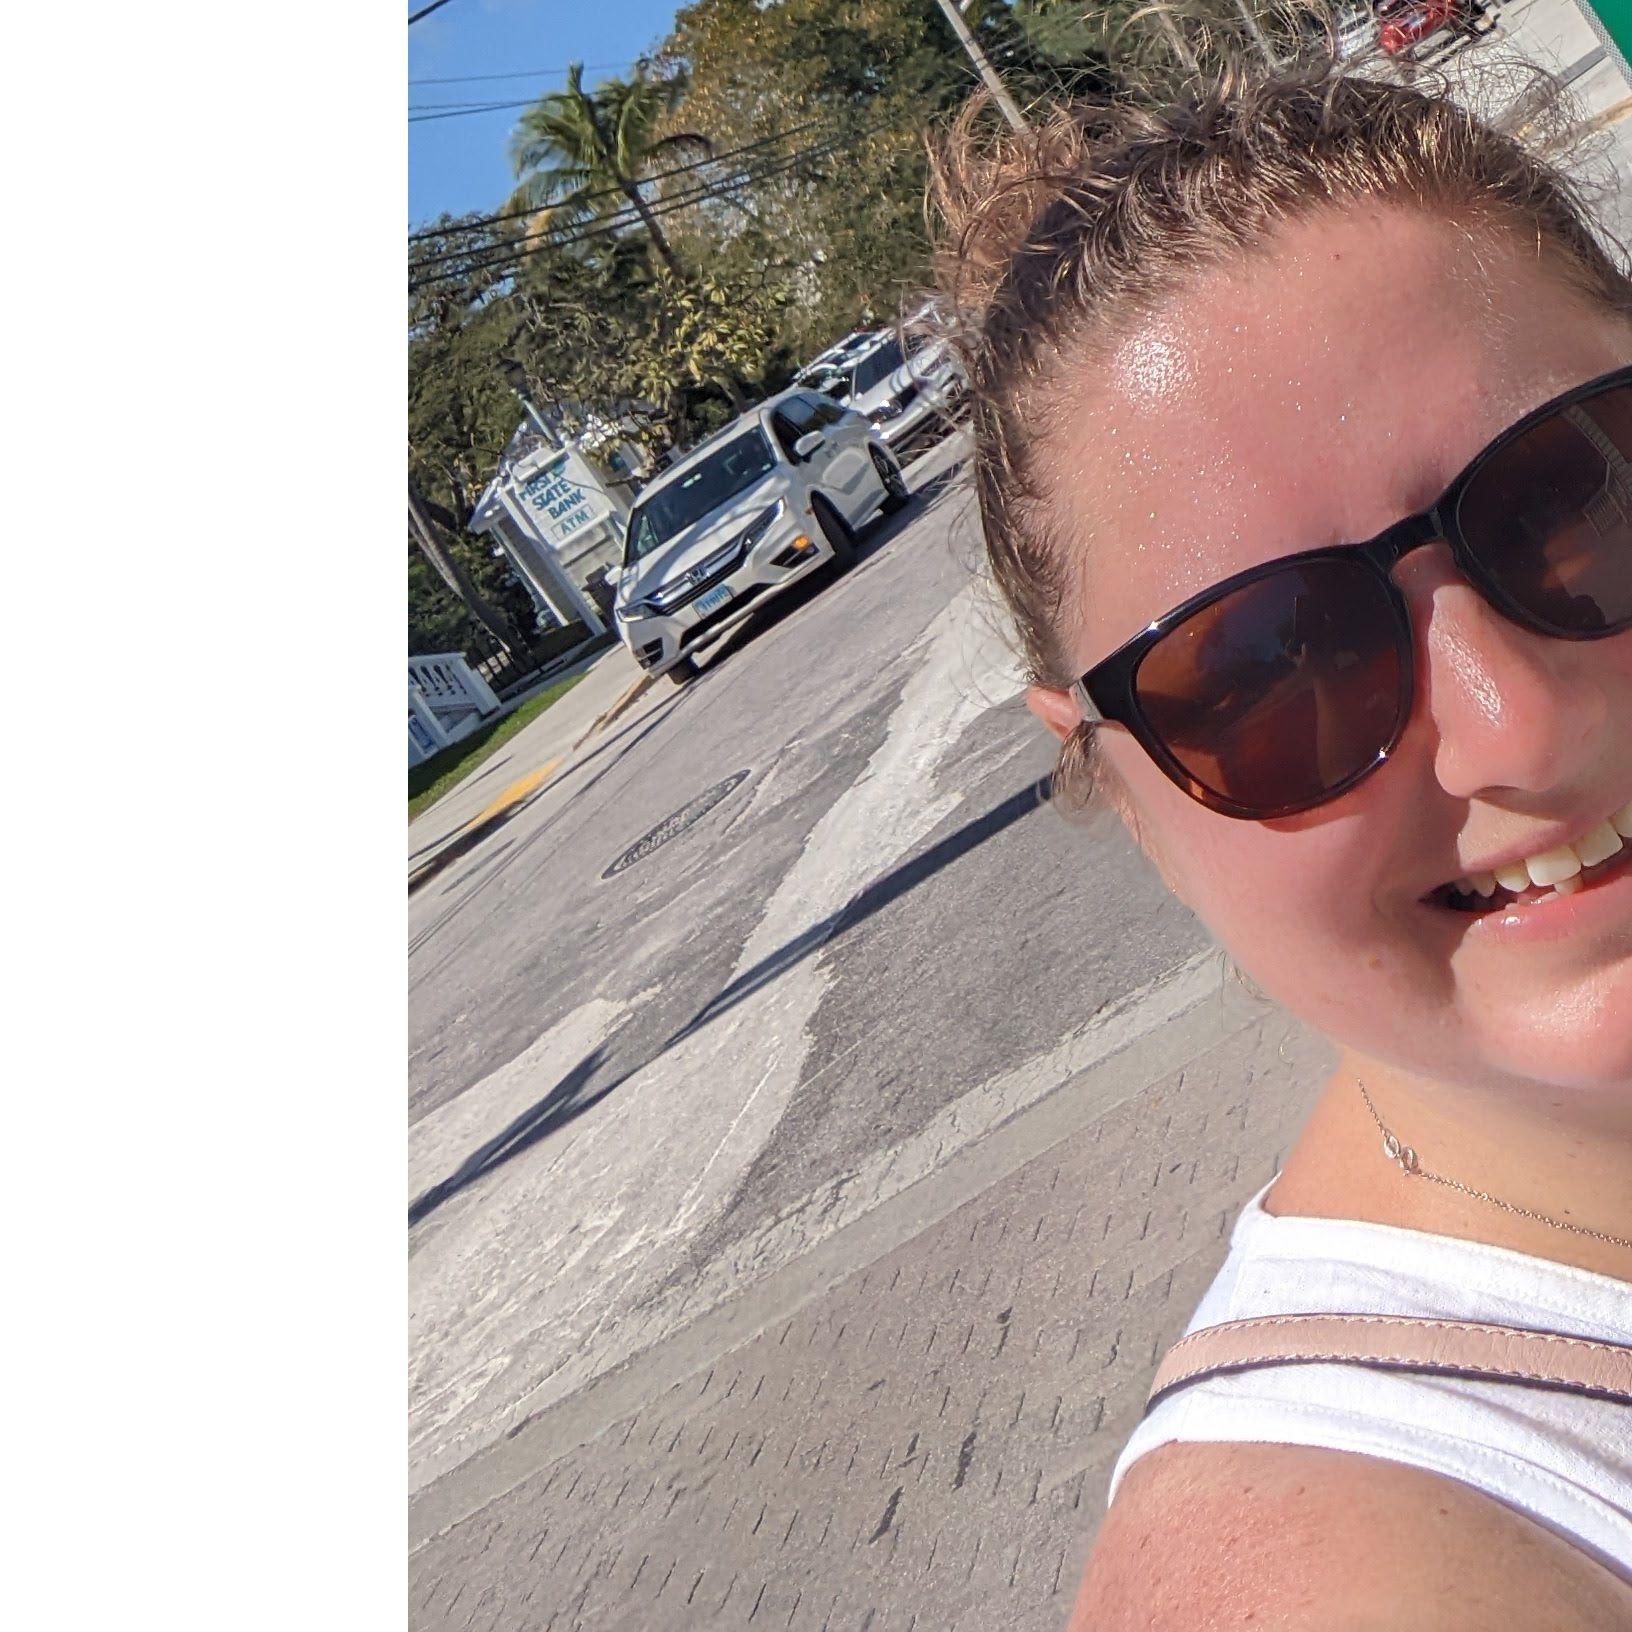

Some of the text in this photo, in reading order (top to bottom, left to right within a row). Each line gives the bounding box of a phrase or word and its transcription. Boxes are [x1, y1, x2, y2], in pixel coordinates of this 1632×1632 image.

[532, 477, 571, 510] STATE
[548, 489, 586, 519] BANK
[560, 510, 589, 536] ATM
